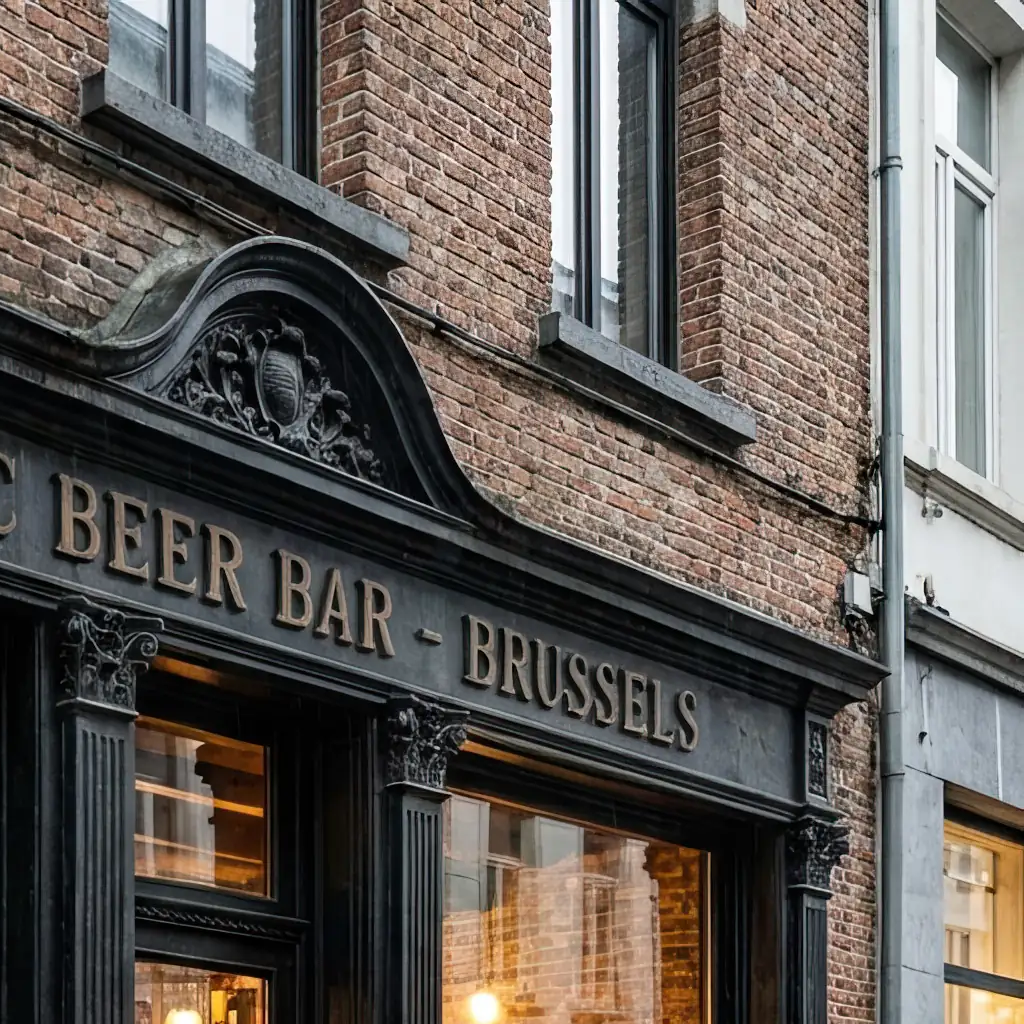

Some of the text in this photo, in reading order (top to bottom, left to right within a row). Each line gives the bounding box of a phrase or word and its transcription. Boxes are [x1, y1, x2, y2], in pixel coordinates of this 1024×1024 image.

[55, 473, 247, 612] BEER
[276, 548, 395, 657] BAR
[463, 613, 699, 752] BRUSSELS
